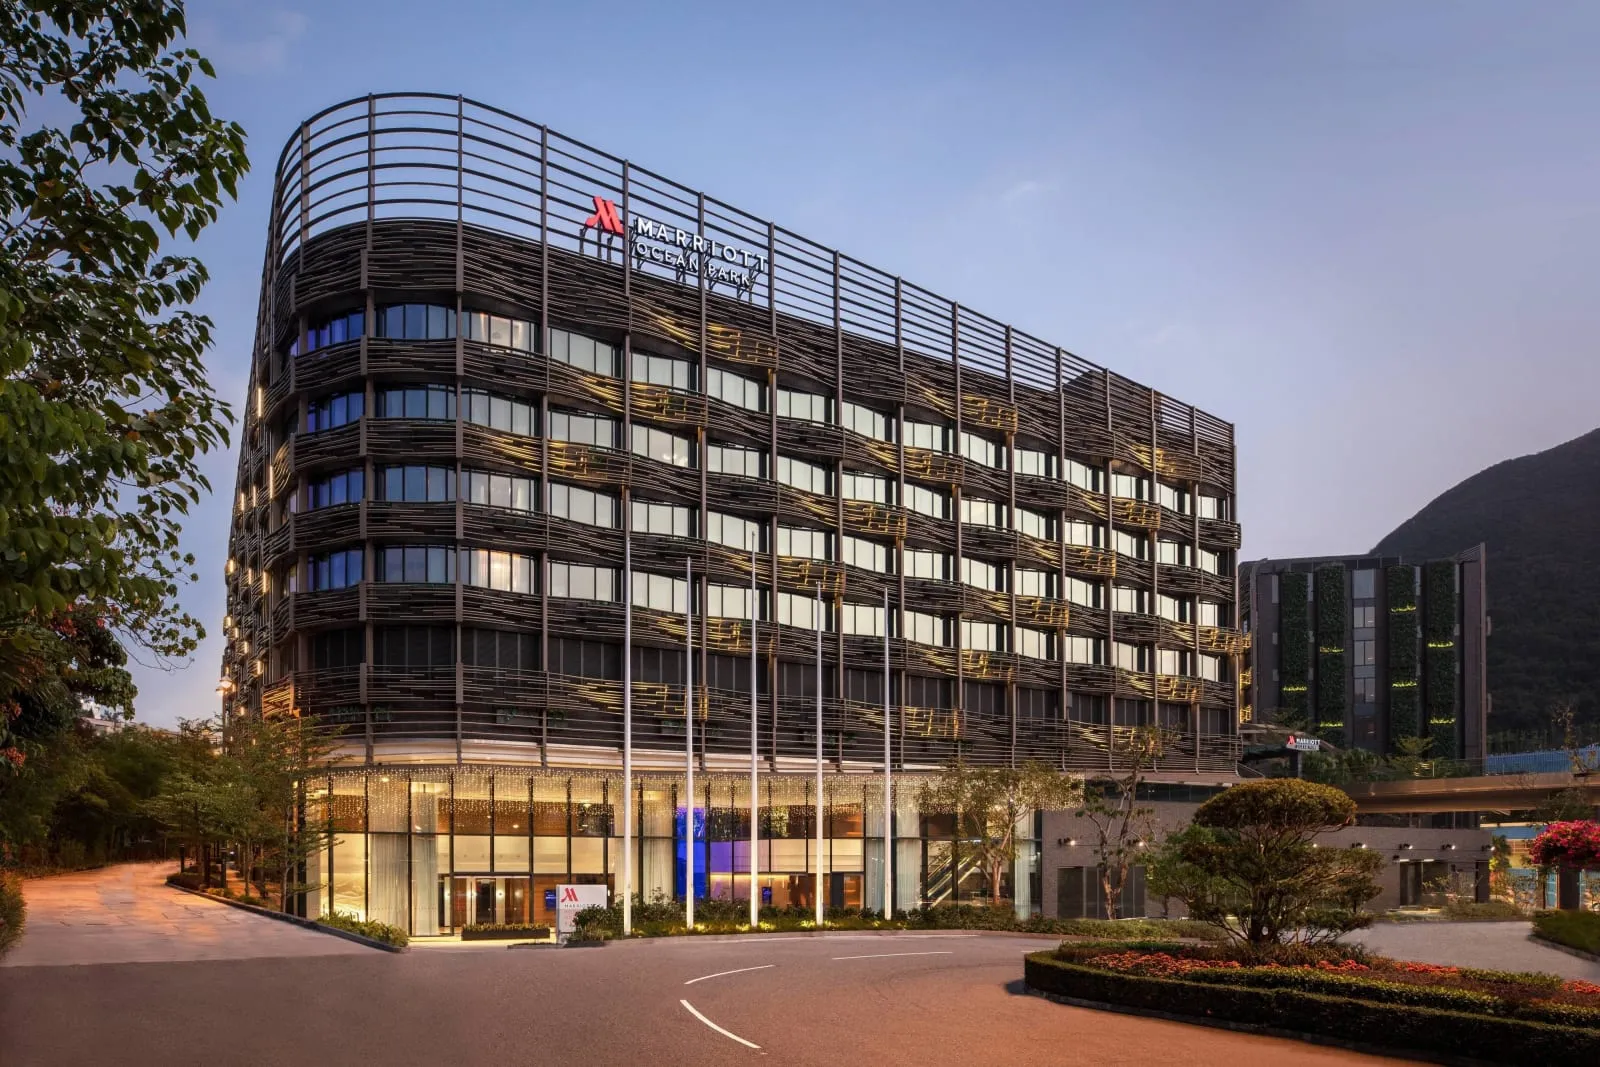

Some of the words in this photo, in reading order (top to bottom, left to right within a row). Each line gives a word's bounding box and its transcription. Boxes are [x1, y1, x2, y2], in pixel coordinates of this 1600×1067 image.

[636, 217, 768, 272] MARRIOTT
[636, 242, 699, 273] OCEAN
[708, 264, 751, 286] PARK
